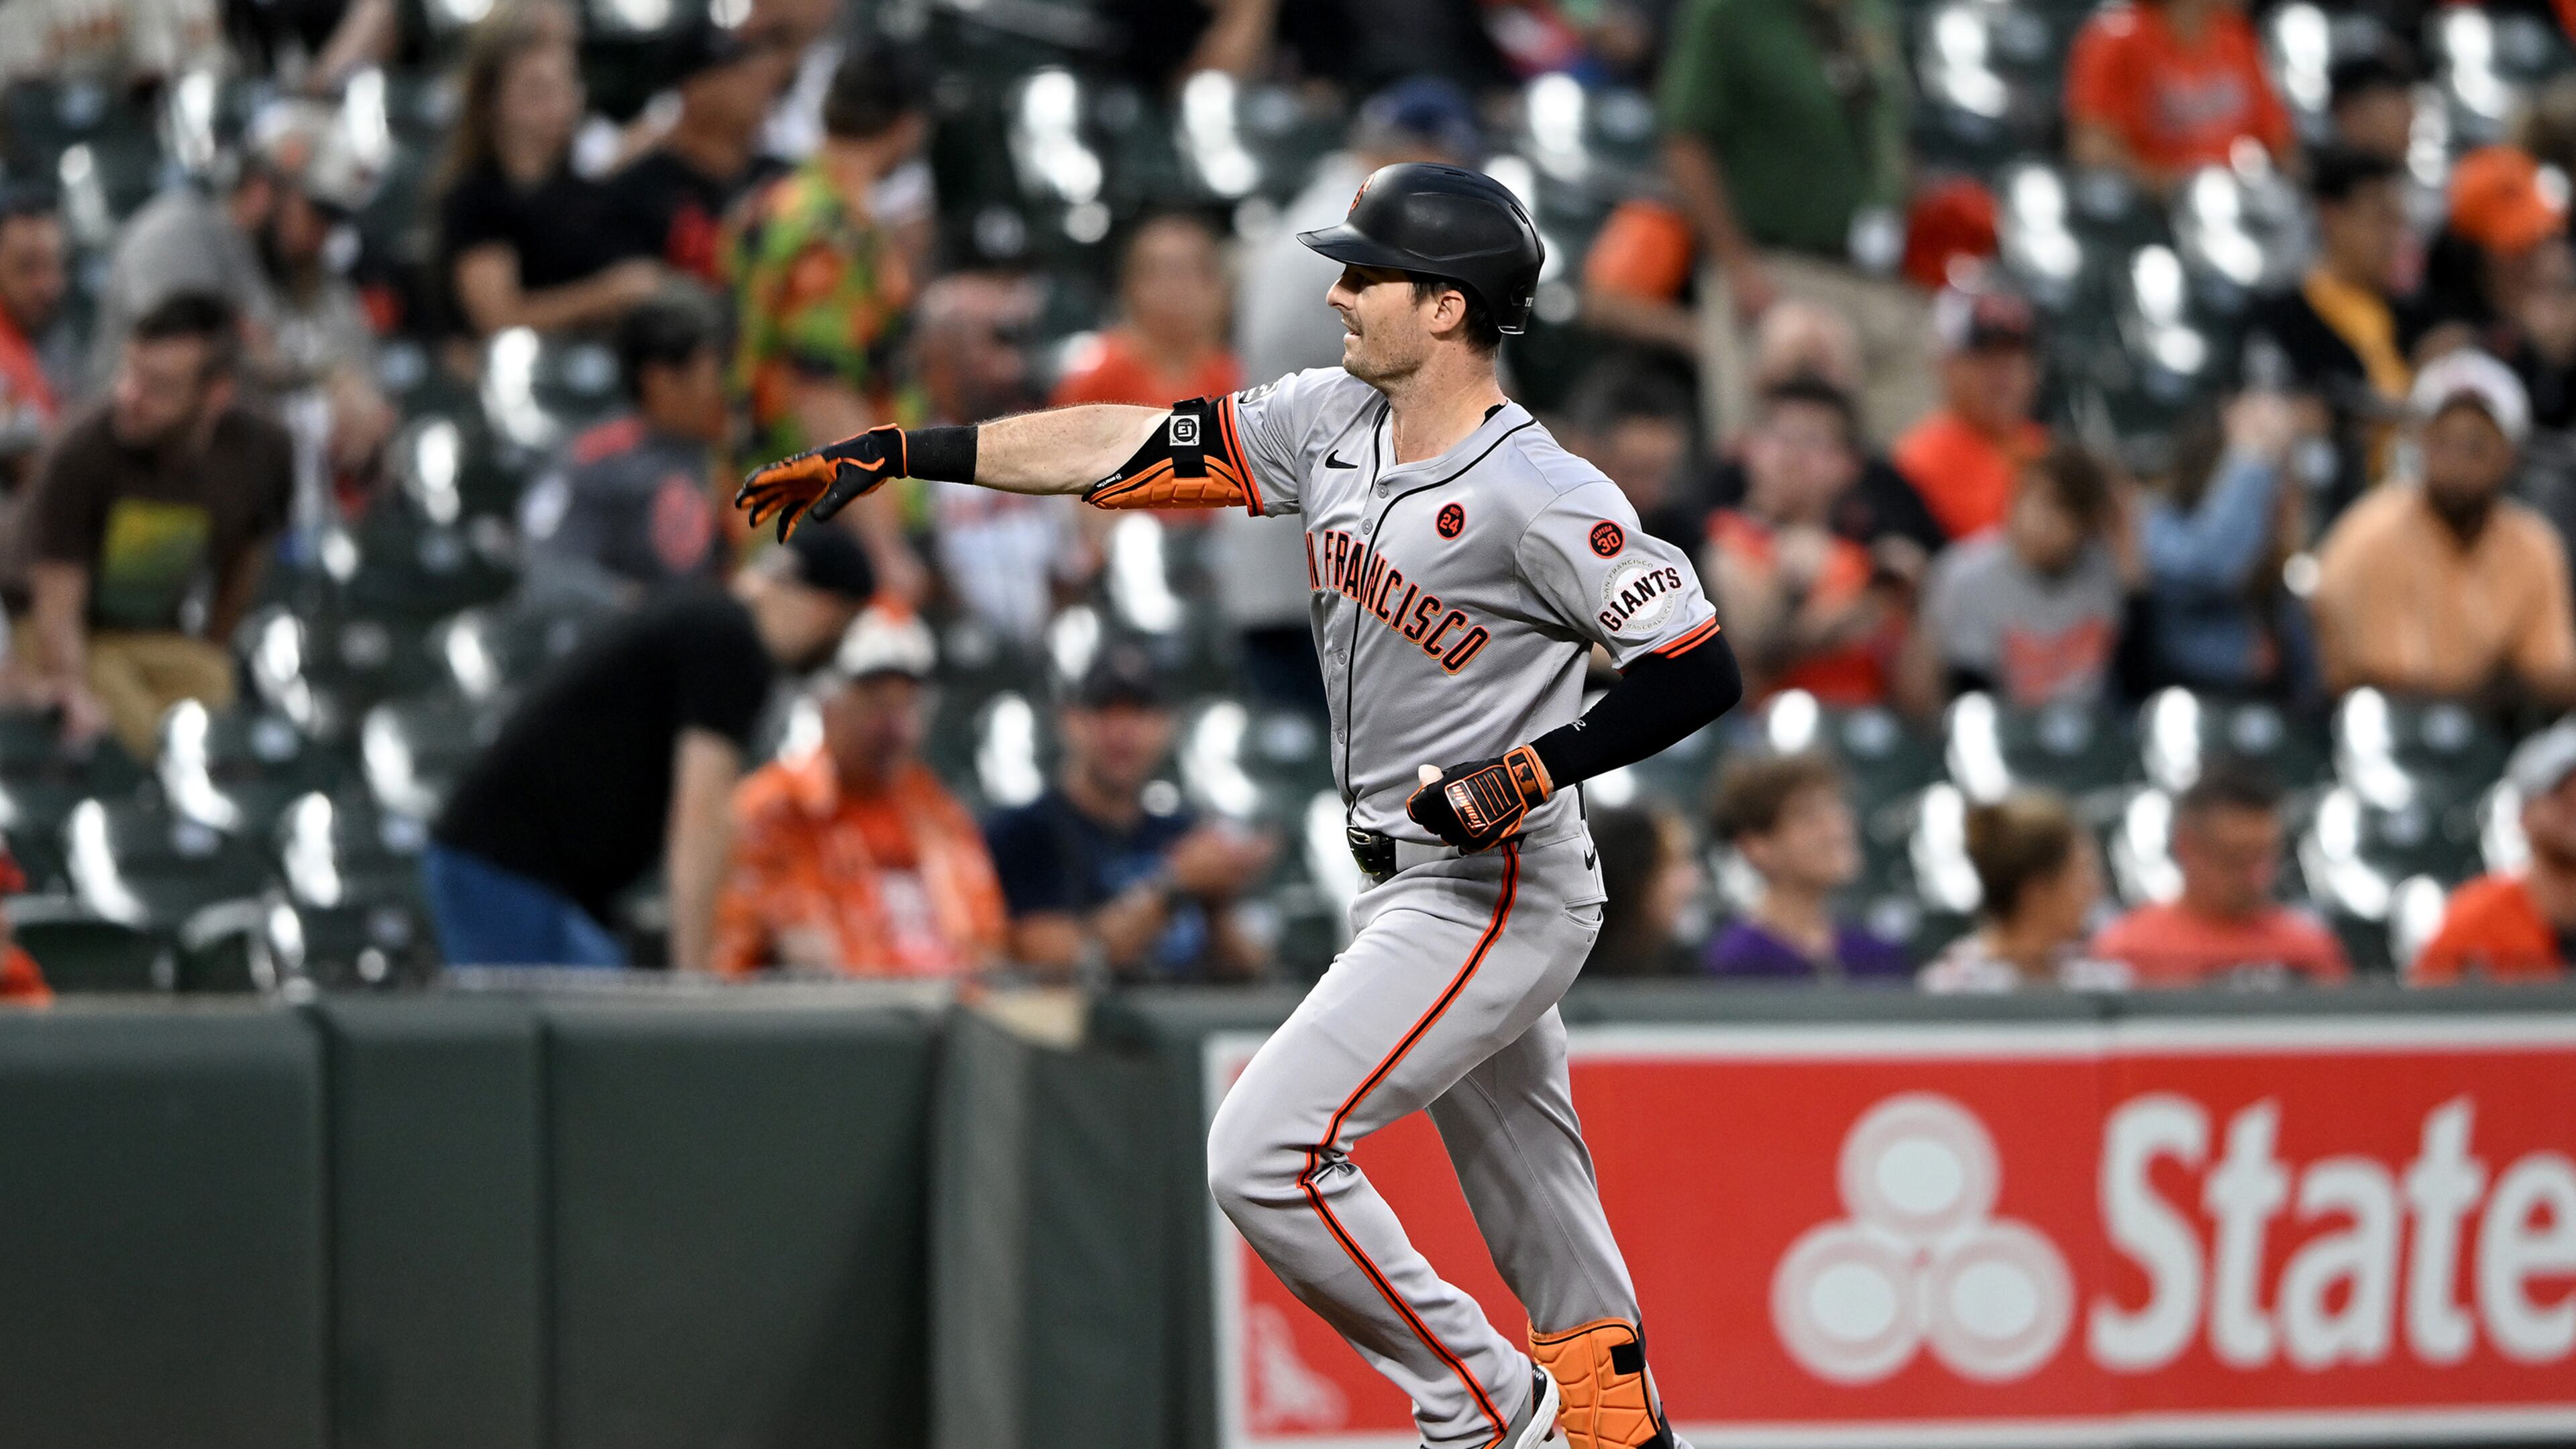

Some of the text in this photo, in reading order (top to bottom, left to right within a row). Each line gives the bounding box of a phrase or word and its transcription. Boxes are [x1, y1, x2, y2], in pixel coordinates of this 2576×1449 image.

[1439, 513, 1460, 534] 24
[1597, 532, 1620, 553] 30
[1325, 529, 1491, 675] FRANCISCO
[1599, 567, 1682, 632] GIANTS
[2084, 1090, 2576, 1377] State
